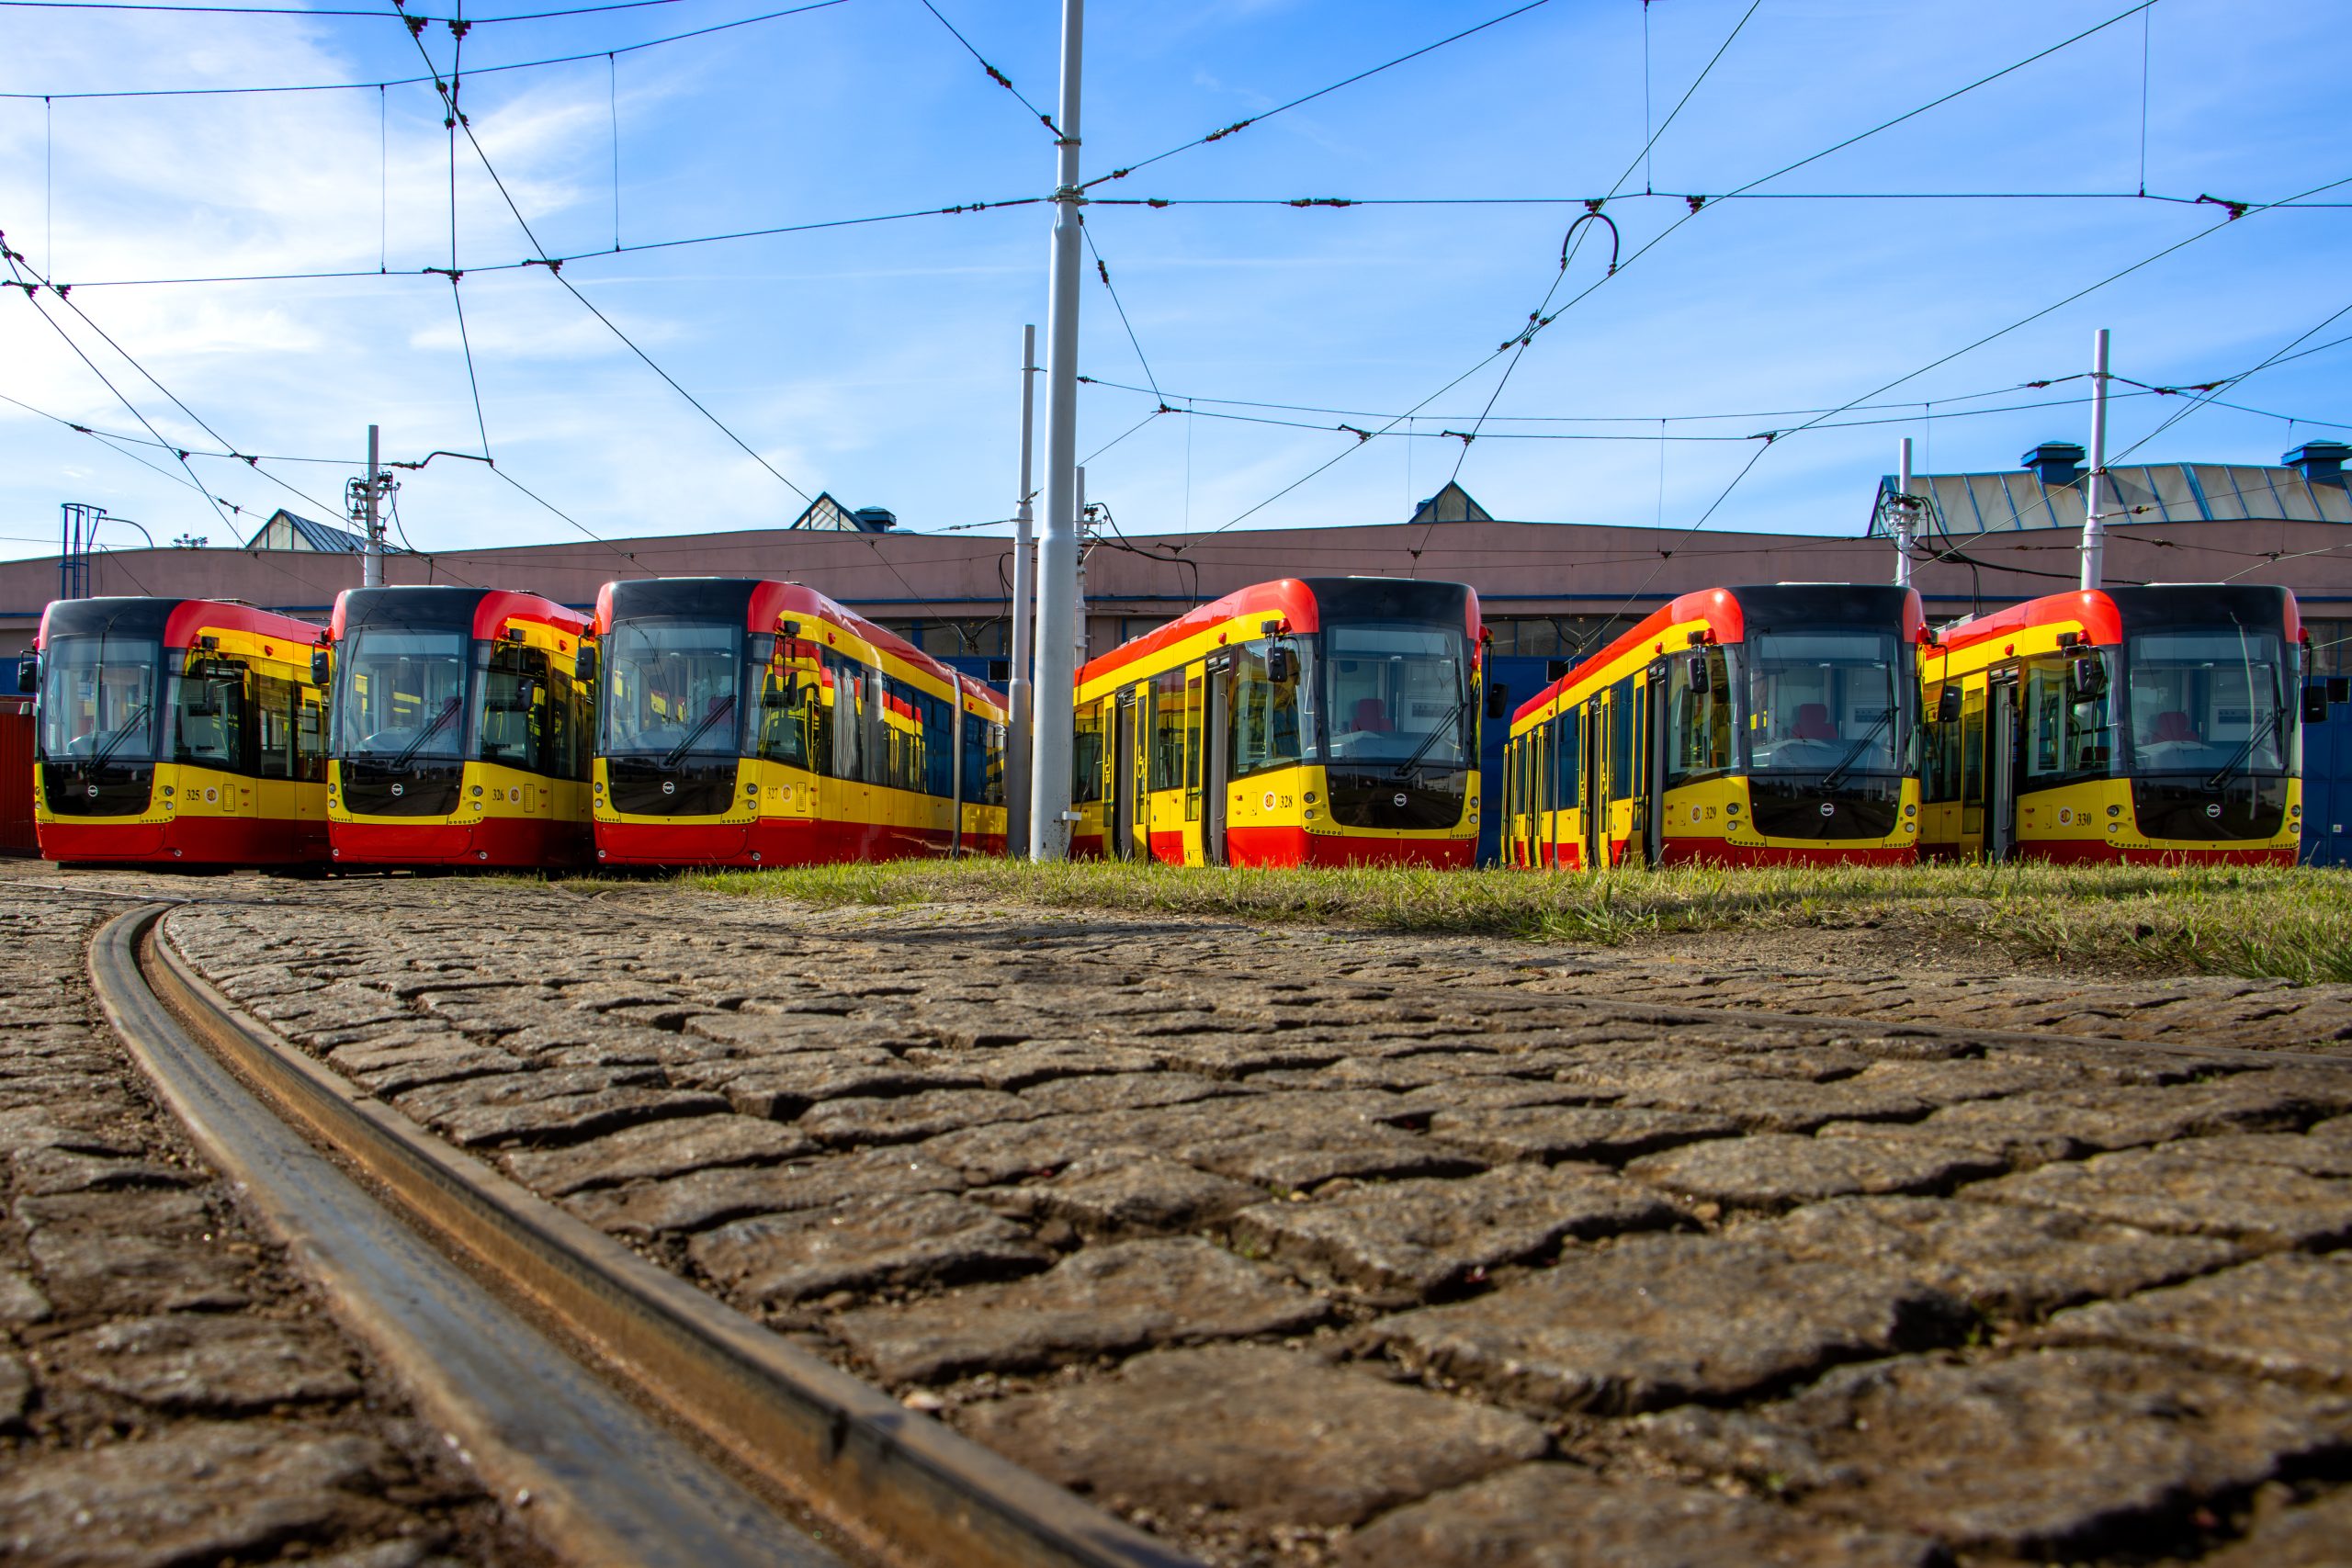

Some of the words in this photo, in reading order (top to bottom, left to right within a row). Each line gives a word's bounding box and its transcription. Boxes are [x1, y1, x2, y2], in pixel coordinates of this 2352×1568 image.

[187, 789, 200, 801] 325
[492, 789, 504, 801] 326
[767, 787, 778, 799] 327
[1281, 795, 1293, 808] 328
[1705, 807, 1717, 819] 329
[2076, 813, 2092, 826] 330
